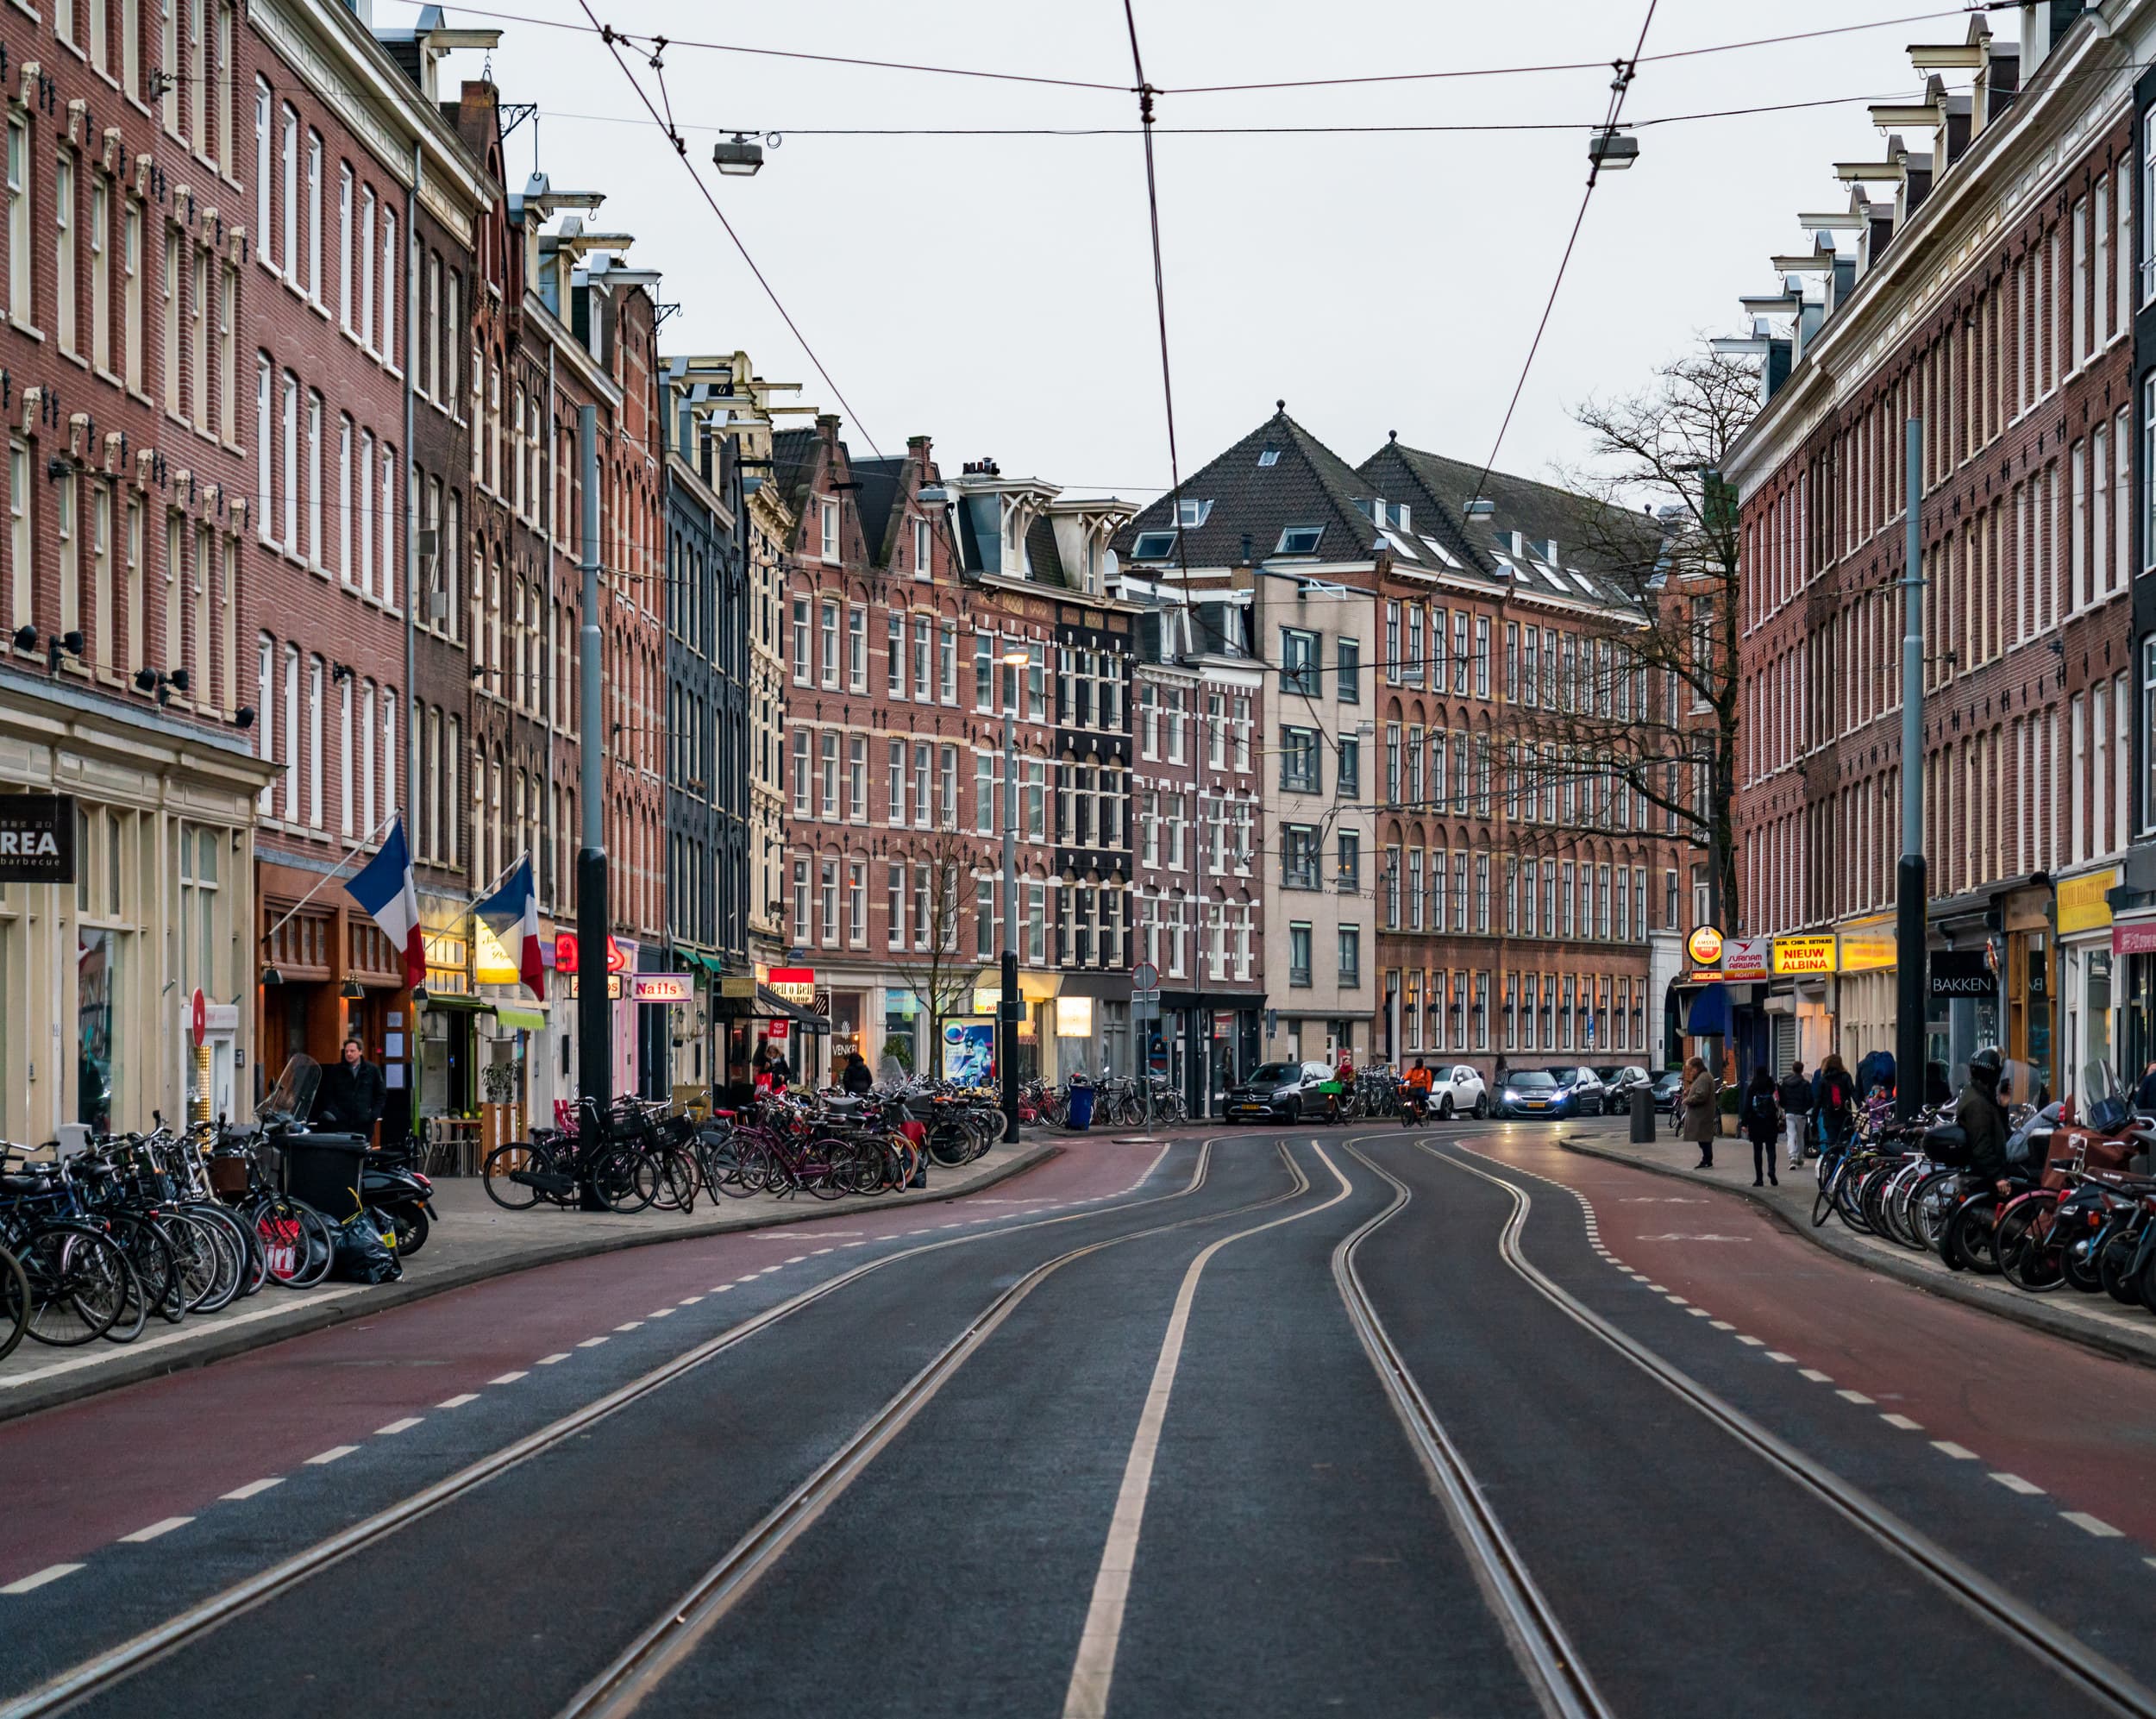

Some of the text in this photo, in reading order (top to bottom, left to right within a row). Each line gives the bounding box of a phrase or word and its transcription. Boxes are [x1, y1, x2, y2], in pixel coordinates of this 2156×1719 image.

[1, 857, 60, 866] barbecue
[1783, 949, 1824, 959] NIEUW
[1783, 959, 1827, 970] ALBINA
[636, 982, 677, 994] Nails
[771, 983, 812, 994] Bell o Bell
[1933, 977, 1990, 991] BAKKEN
[266, 1244, 295, 1270] irk
